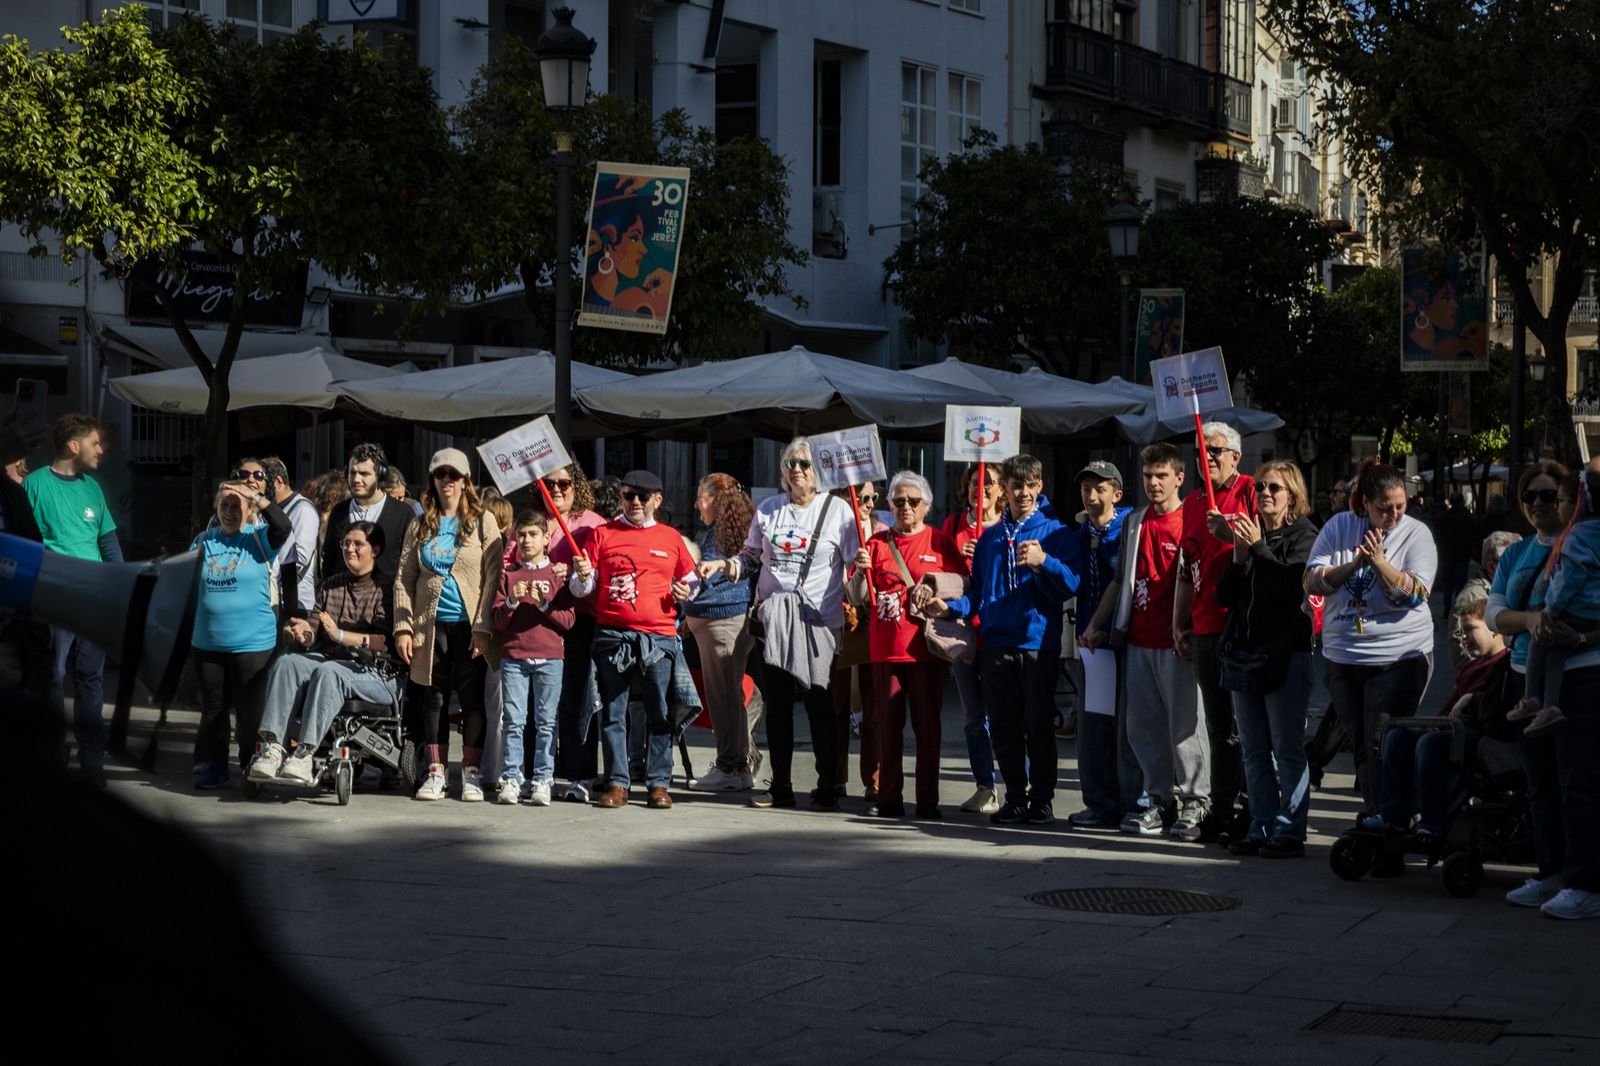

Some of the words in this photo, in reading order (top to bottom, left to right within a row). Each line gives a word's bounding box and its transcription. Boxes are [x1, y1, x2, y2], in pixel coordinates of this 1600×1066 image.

[652, 179, 682, 206] 30
[664, 209, 679, 217] FES
[658, 216, 678, 226] TIVAL
[665, 225, 677, 235] DE
[651, 233, 676, 243] JEREZ
[1141, 298, 1156, 315] 30
[1181, 372, 1216, 385] Duchenne
[511, 438, 547, 458] Duchenne
[525, 443, 551, 458] España
[836, 446, 870, 458] Duchenne
[206, 577, 238, 587] UNIPER
